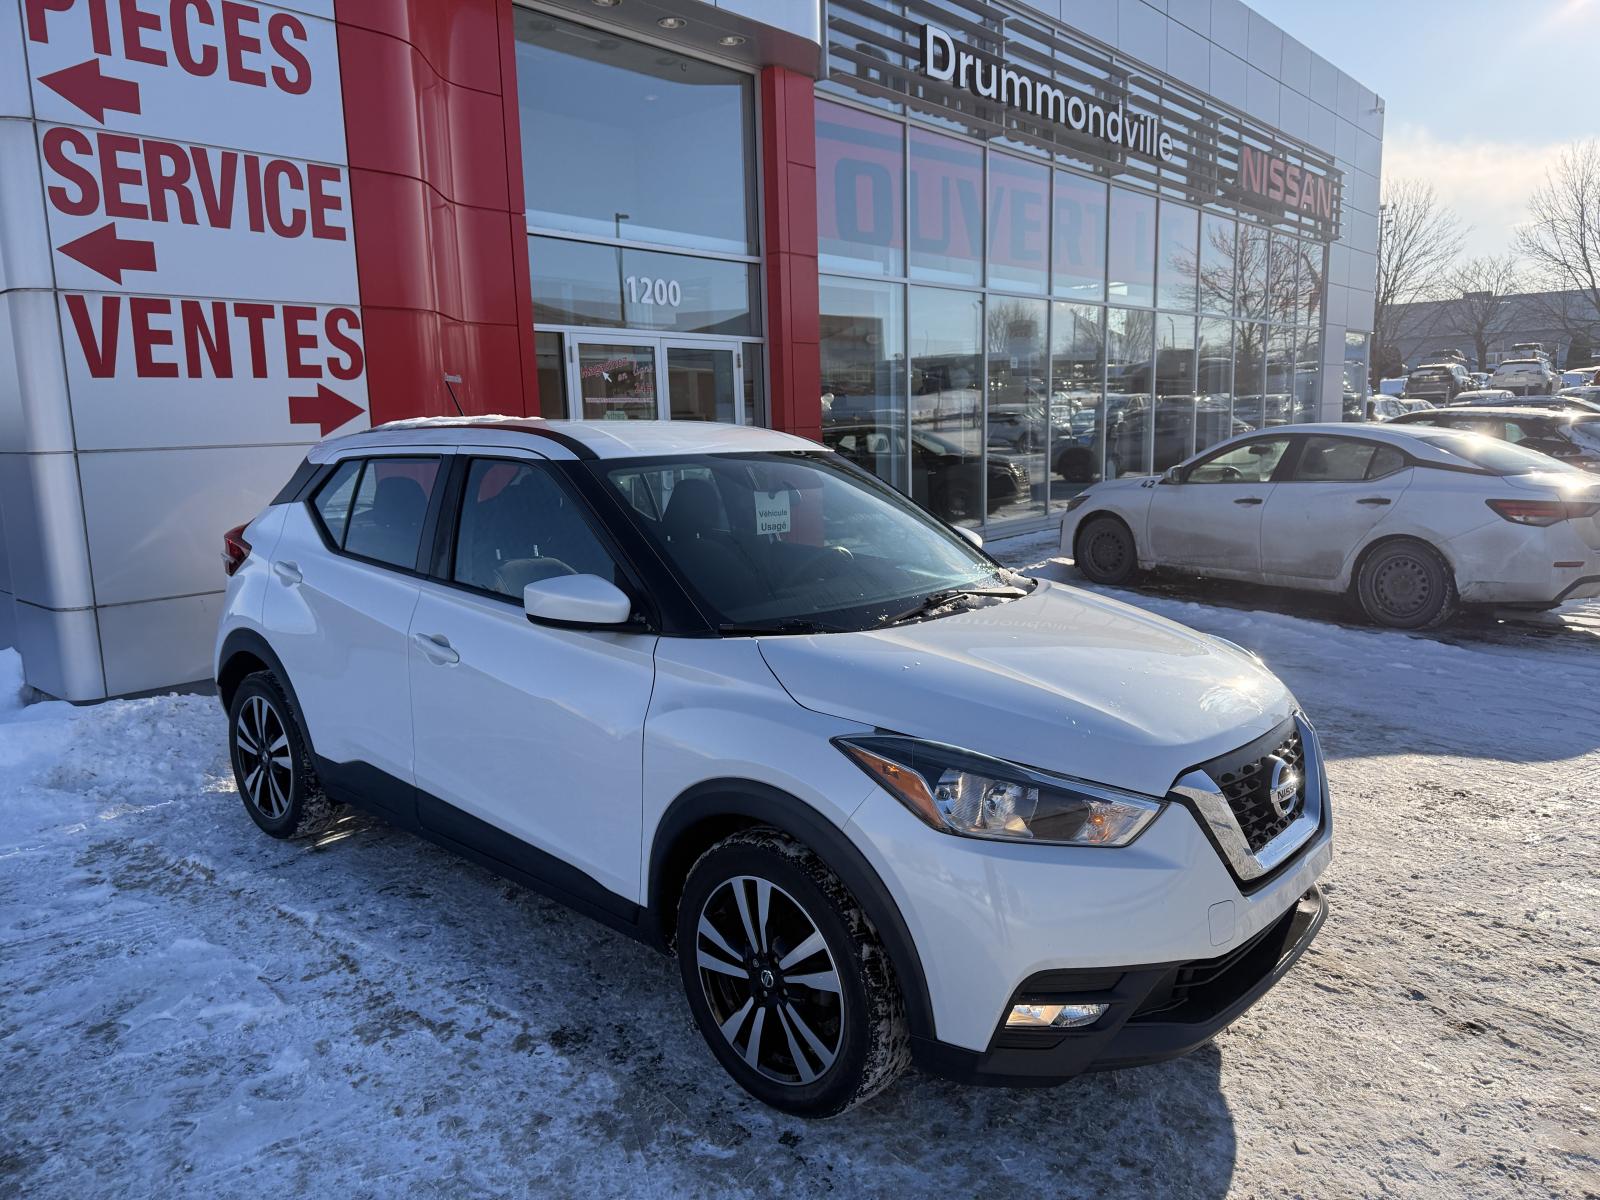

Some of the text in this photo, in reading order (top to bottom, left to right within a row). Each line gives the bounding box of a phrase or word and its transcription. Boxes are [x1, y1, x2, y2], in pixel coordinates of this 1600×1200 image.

[926, 24, 1174, 162] Drummondville
[43, 127, 347, 242] SERVICE
[834, 157, 1118, 268] OUVERT
[1242, 145, 1332, 219] NISSAN
[626, 276, 681, 307] 1200
[65, 295, 365, 382] VENTES
[759, 508, 788, 518] Véhicule
[761, 521, 787, 532] Usagé
[1277, 784, 1297, 800] NISS
